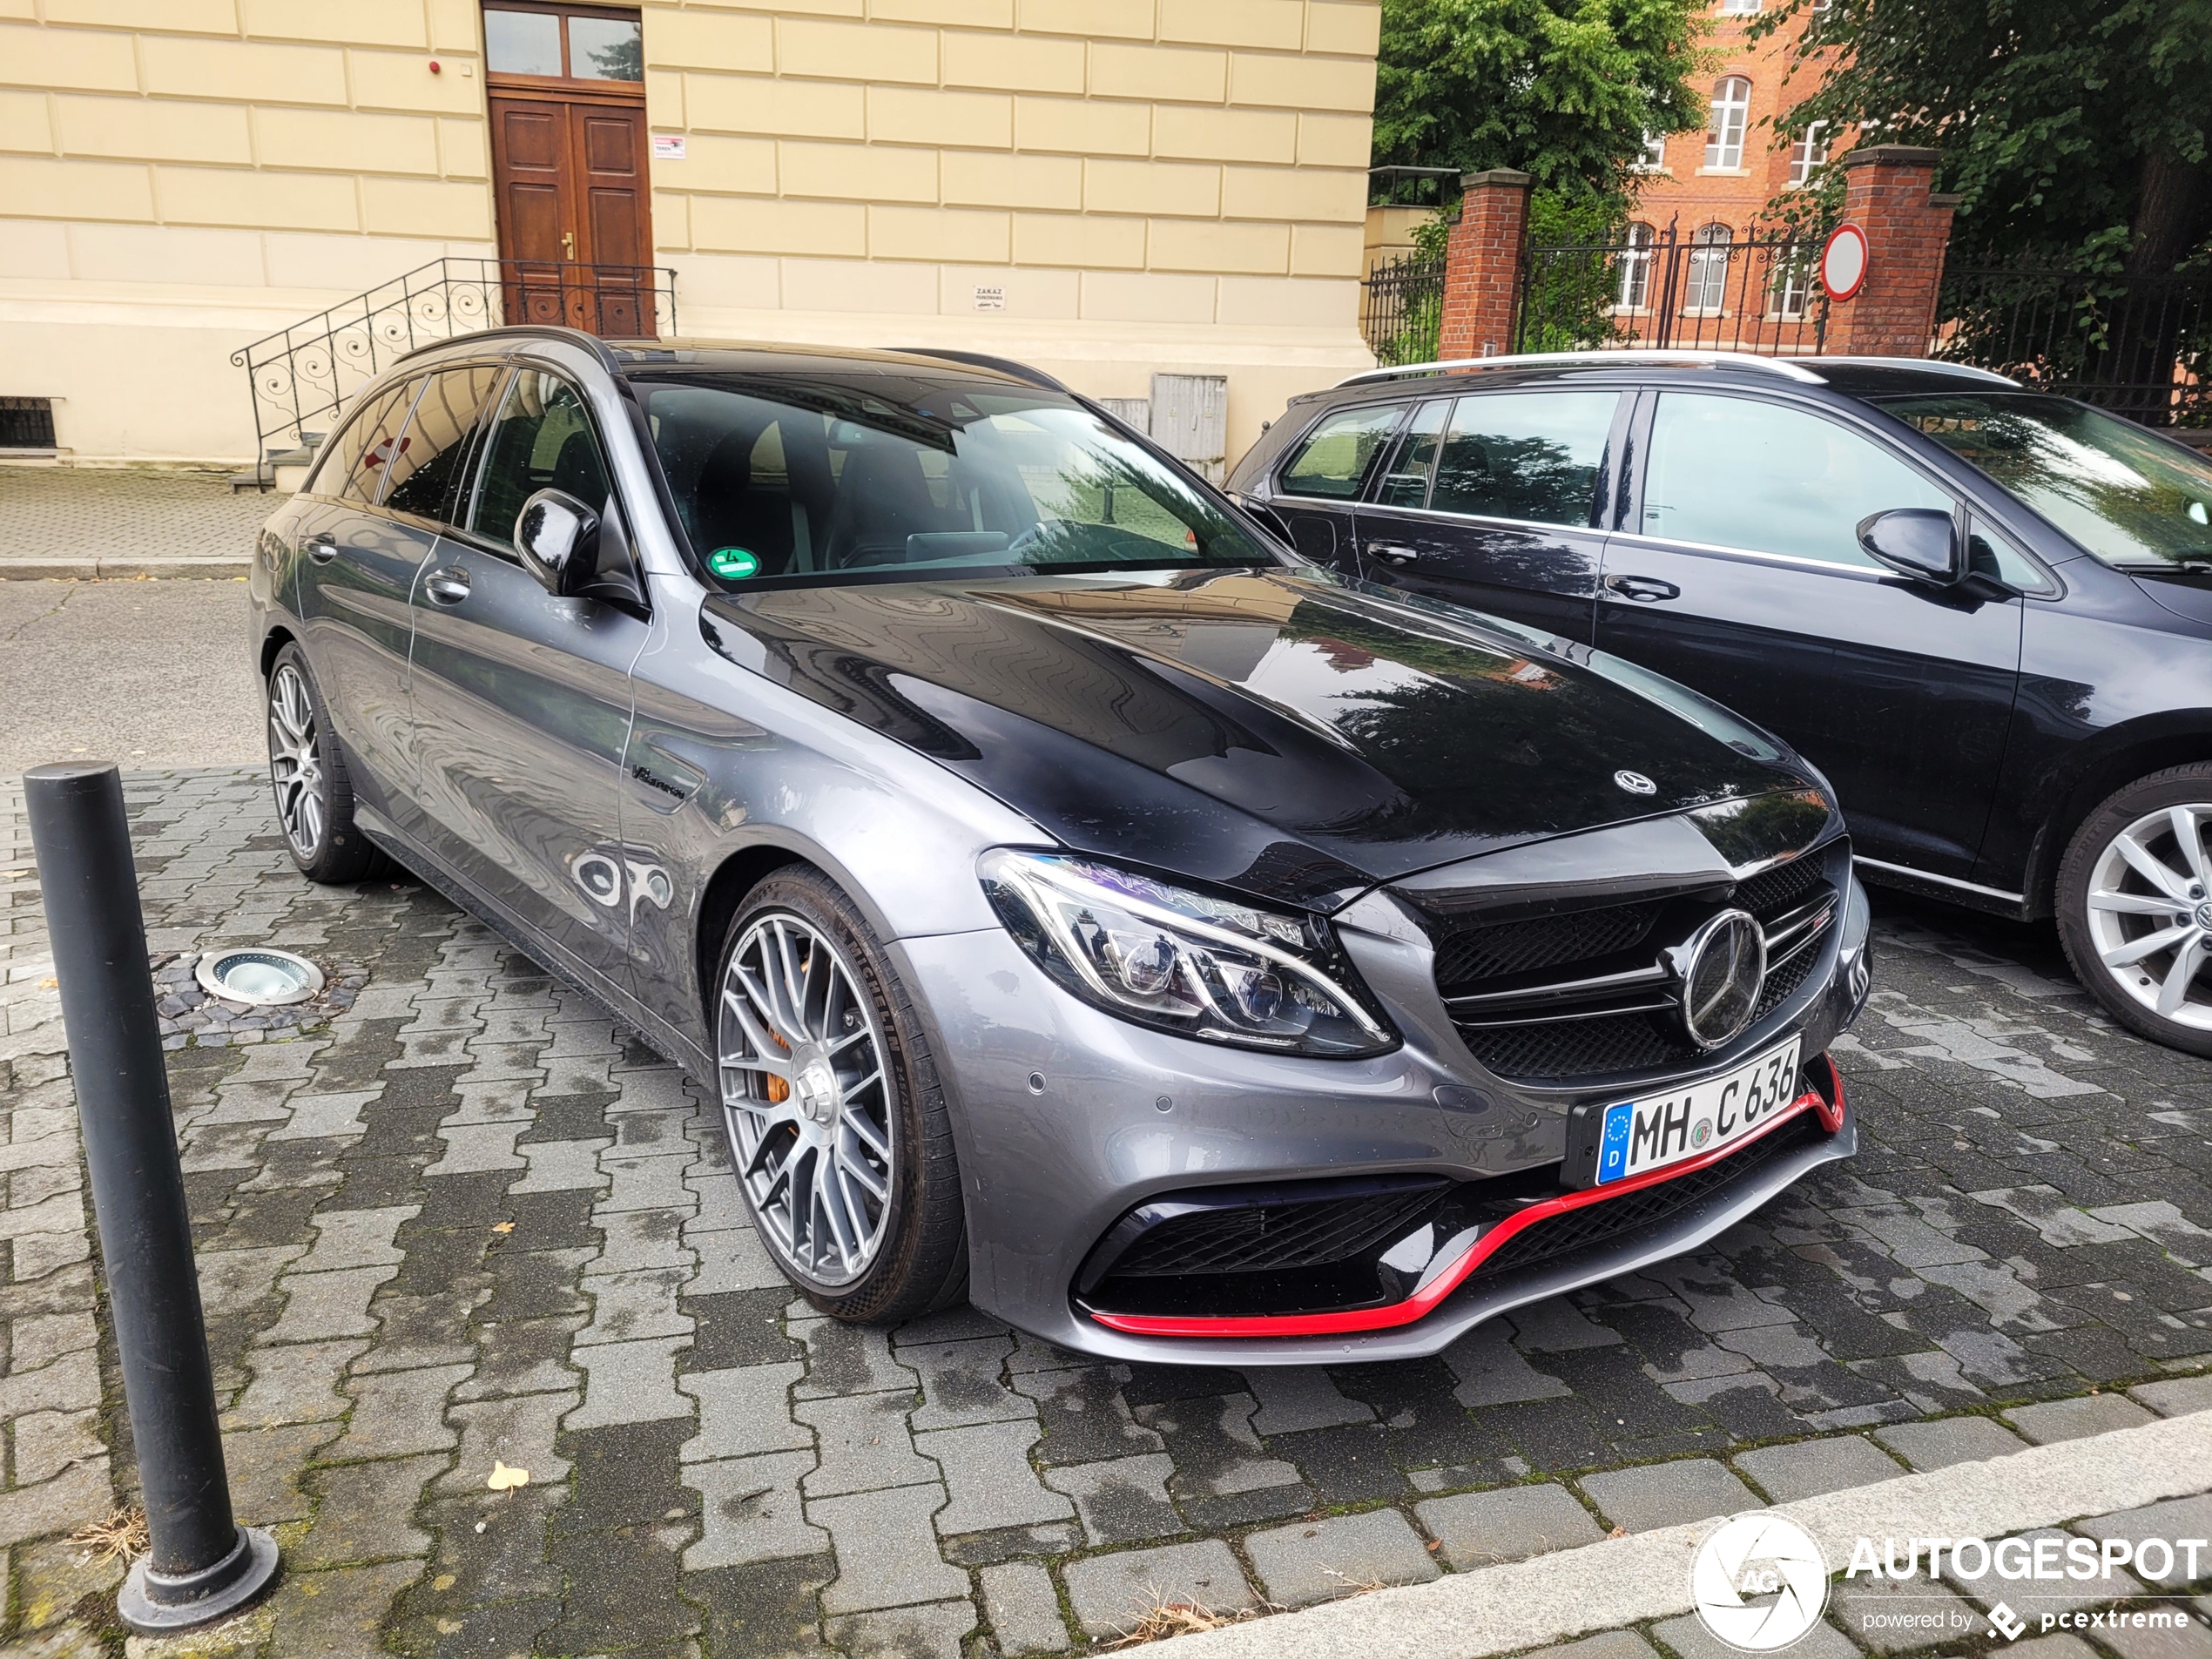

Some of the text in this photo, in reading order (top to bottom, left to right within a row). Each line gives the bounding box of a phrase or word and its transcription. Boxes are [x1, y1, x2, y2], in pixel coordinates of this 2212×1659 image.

[726, 550, 739, 563] 4
[847, 940, 900, 1052] MICHELIN
[1629, 1048, 1795, 1167] MH C 636
[1608, 1150, 1620, 1167] D
